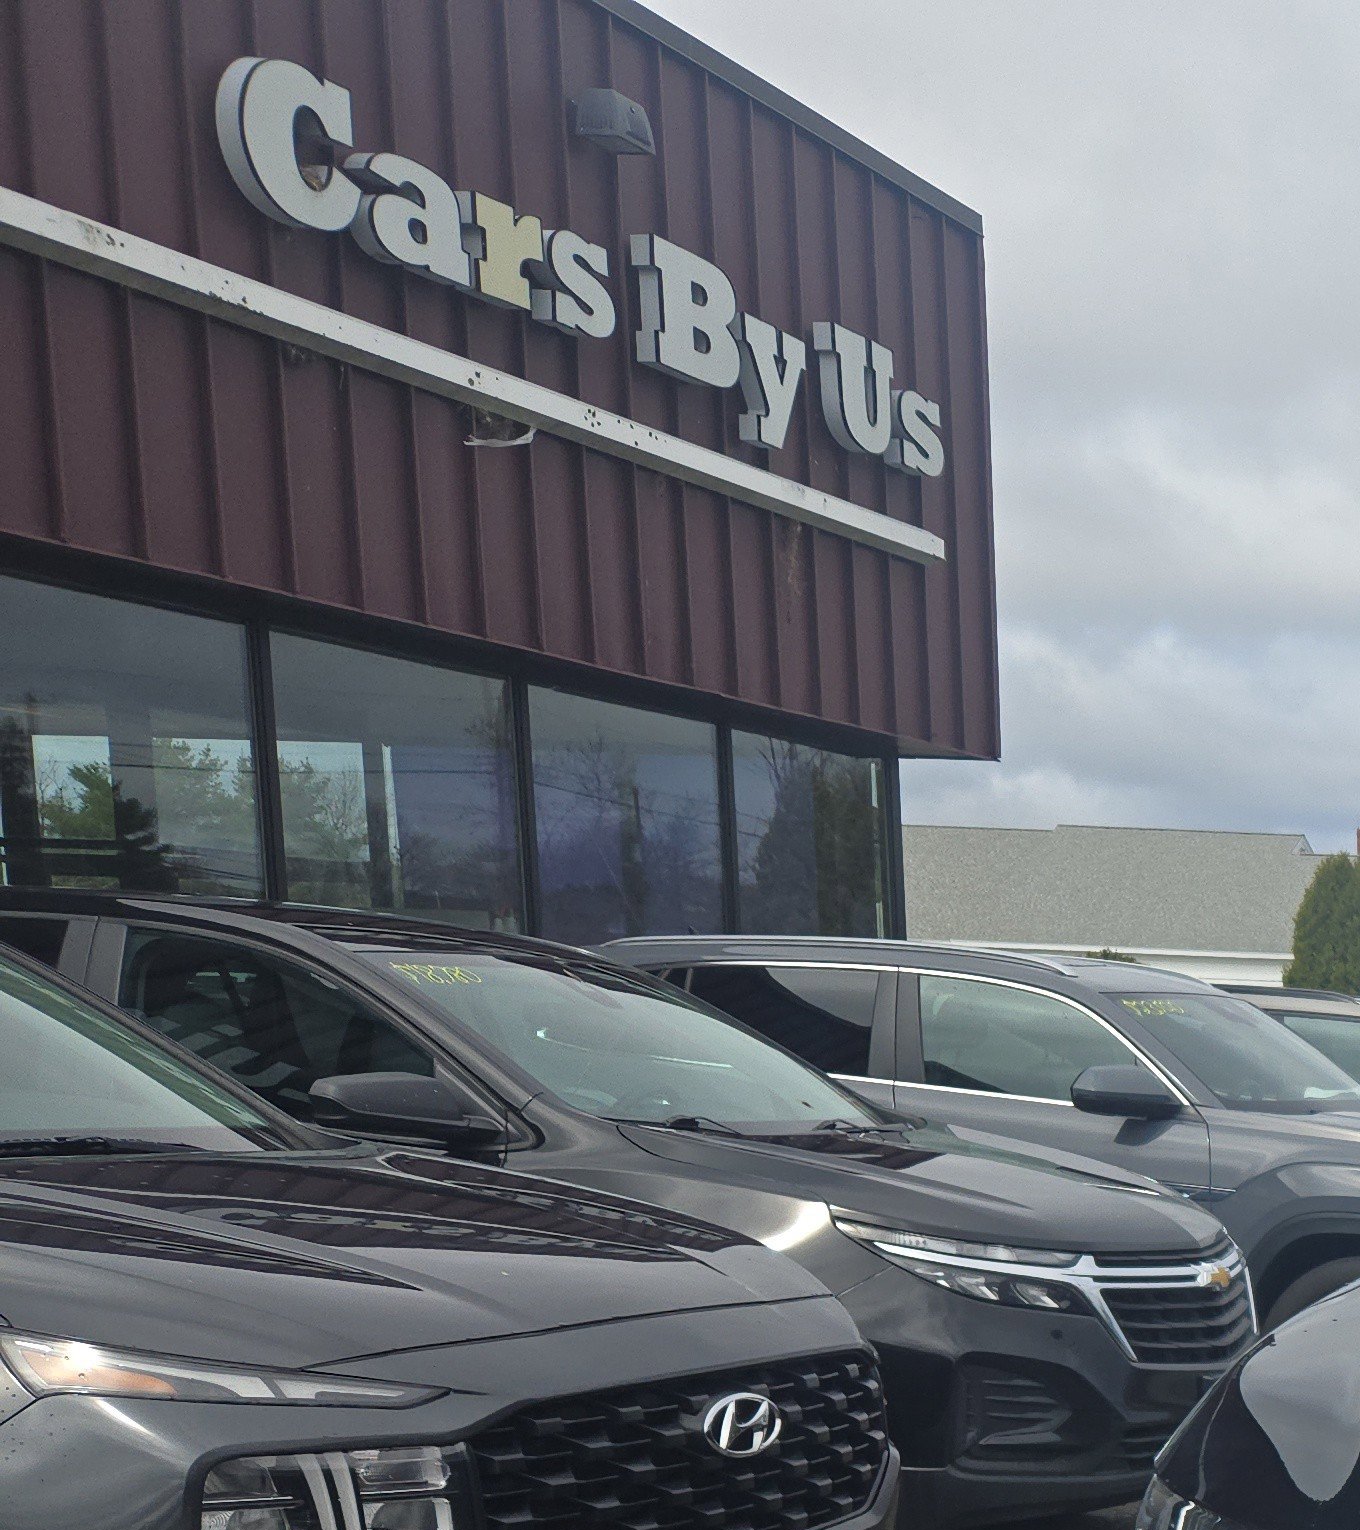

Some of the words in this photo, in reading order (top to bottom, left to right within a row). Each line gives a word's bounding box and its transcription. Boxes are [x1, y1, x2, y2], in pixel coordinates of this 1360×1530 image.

[215, 56, 616, 338] Cars
[630, 233, 806, 449] By
[813, 321, 945, 477] Us
